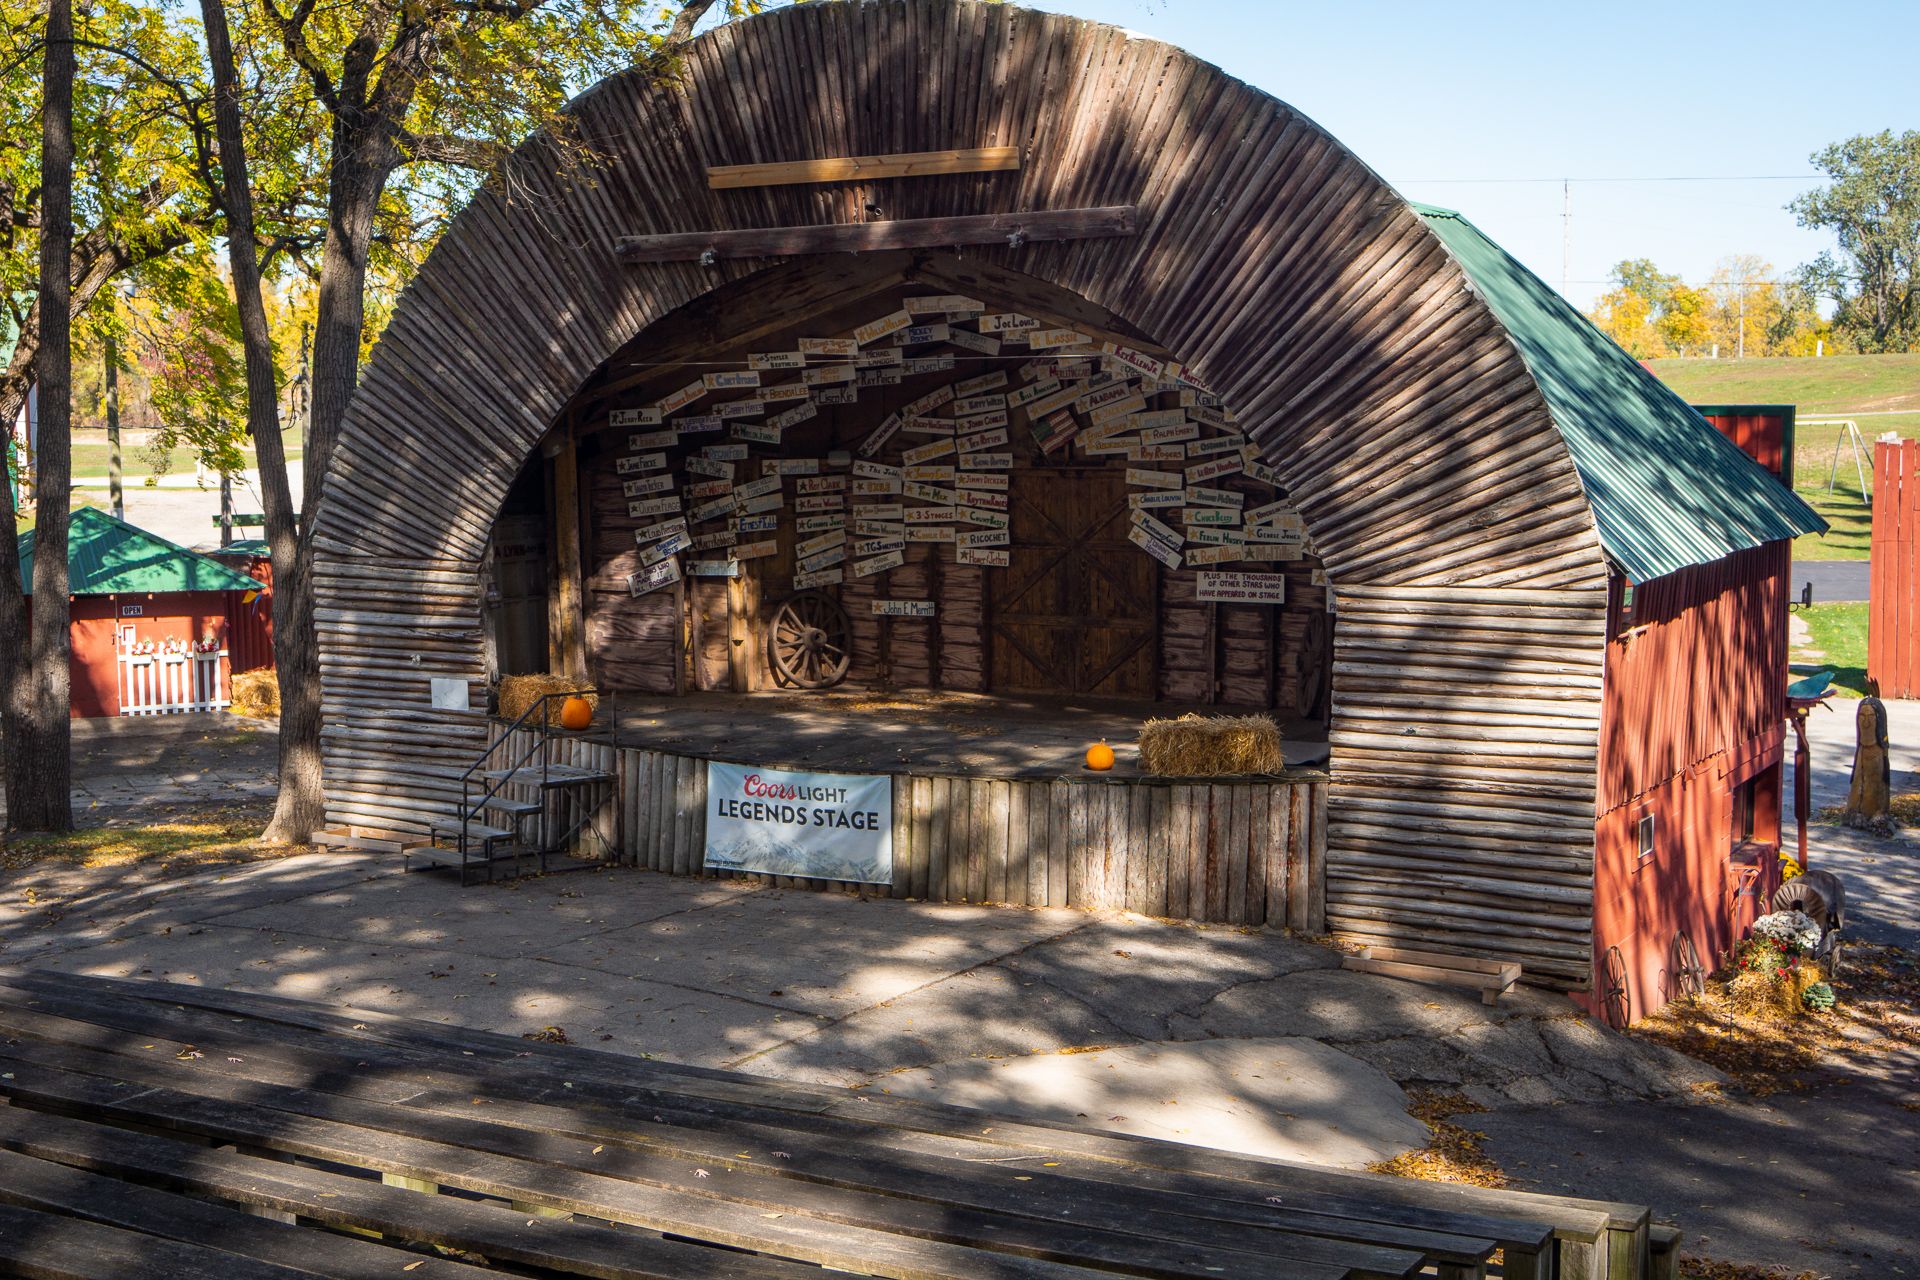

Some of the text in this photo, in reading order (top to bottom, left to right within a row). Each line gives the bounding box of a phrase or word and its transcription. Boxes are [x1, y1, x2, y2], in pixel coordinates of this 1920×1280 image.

[1204, 572, 1221, 580] PLUS
[1242, 574, 1281, 582] THOUSANDS
[1220, 580, 1240, 588] OTHER
[1242, 581, 1263, 589] STARS
[1199, 589, 1215, 597] HAVE
[1216, 590, 1246, 598] APPEARED
[1247, 591, 1257, 599] ON
[124, 606, 141, 615] OPEN
[743, 774, 847, 804] Coors LIGHT
[718, 798, 879, 831] LEGENDS STAGE
